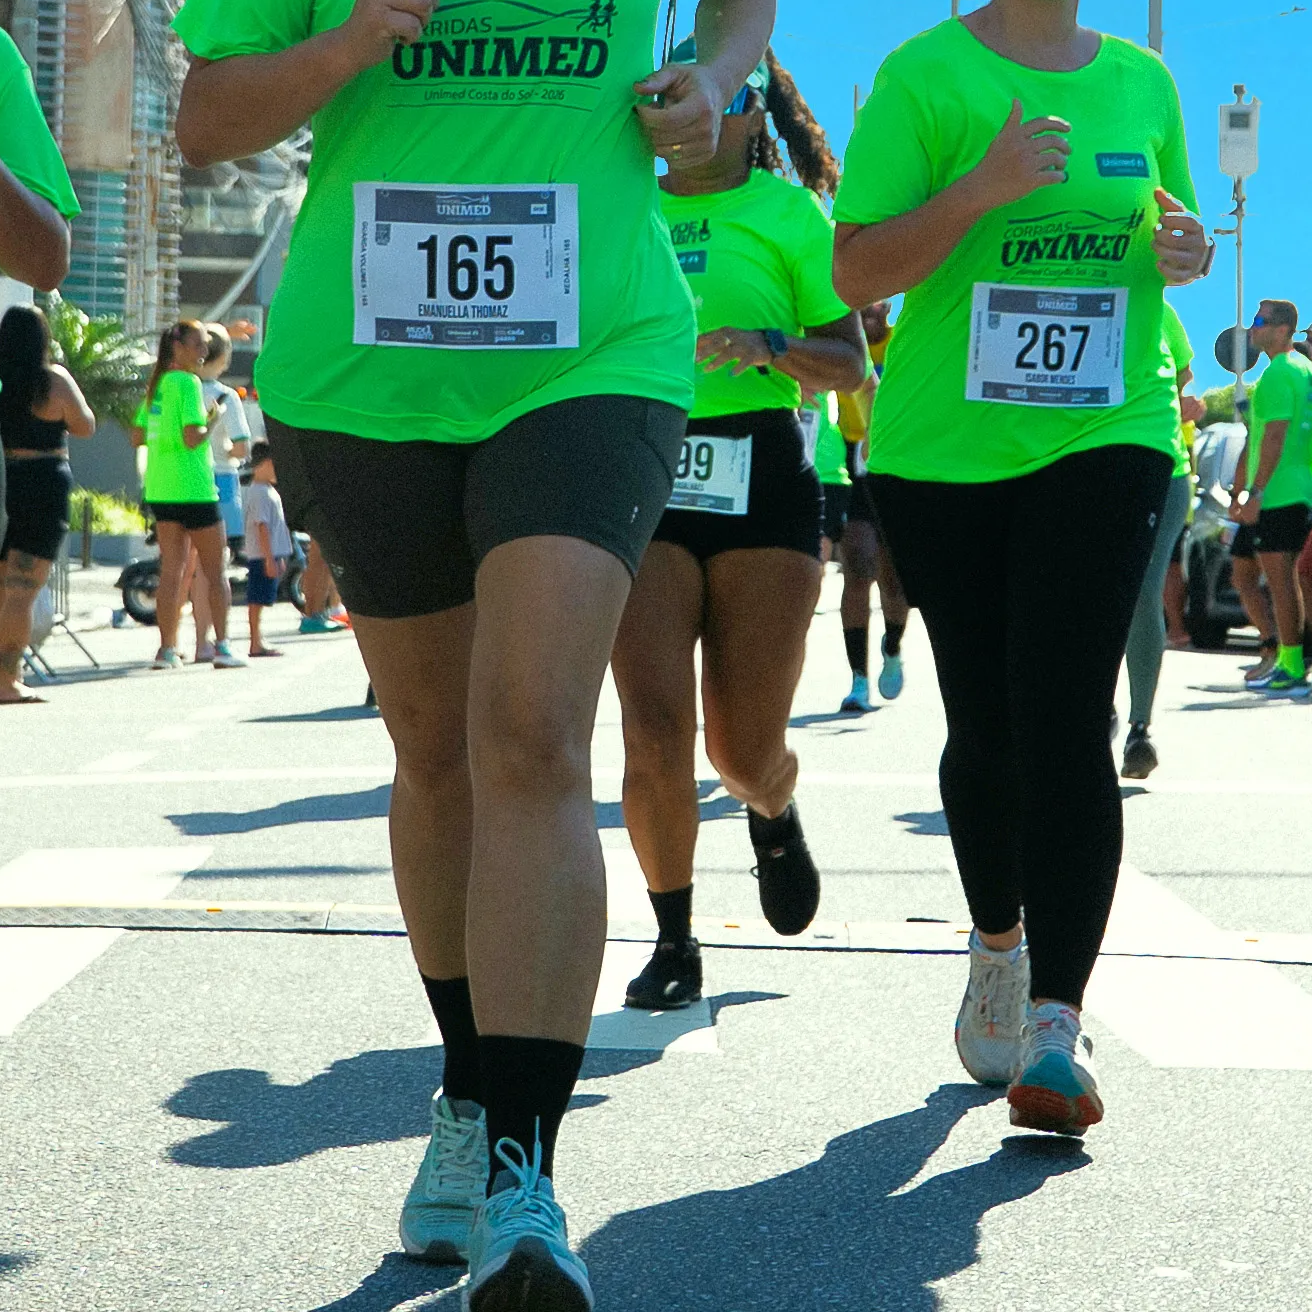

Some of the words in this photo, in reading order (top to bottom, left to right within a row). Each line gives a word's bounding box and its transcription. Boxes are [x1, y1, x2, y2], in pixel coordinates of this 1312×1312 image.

[391, 36, 609, 80] UNIMED
[424, 89, 466, 101] Unimed
[437, 204, 491, 217] UNIMED
[417, 234, 515, 301] 165
[471, 305, 508, 318] THOMAZ
[1015, 321, 1090, 372] 267
